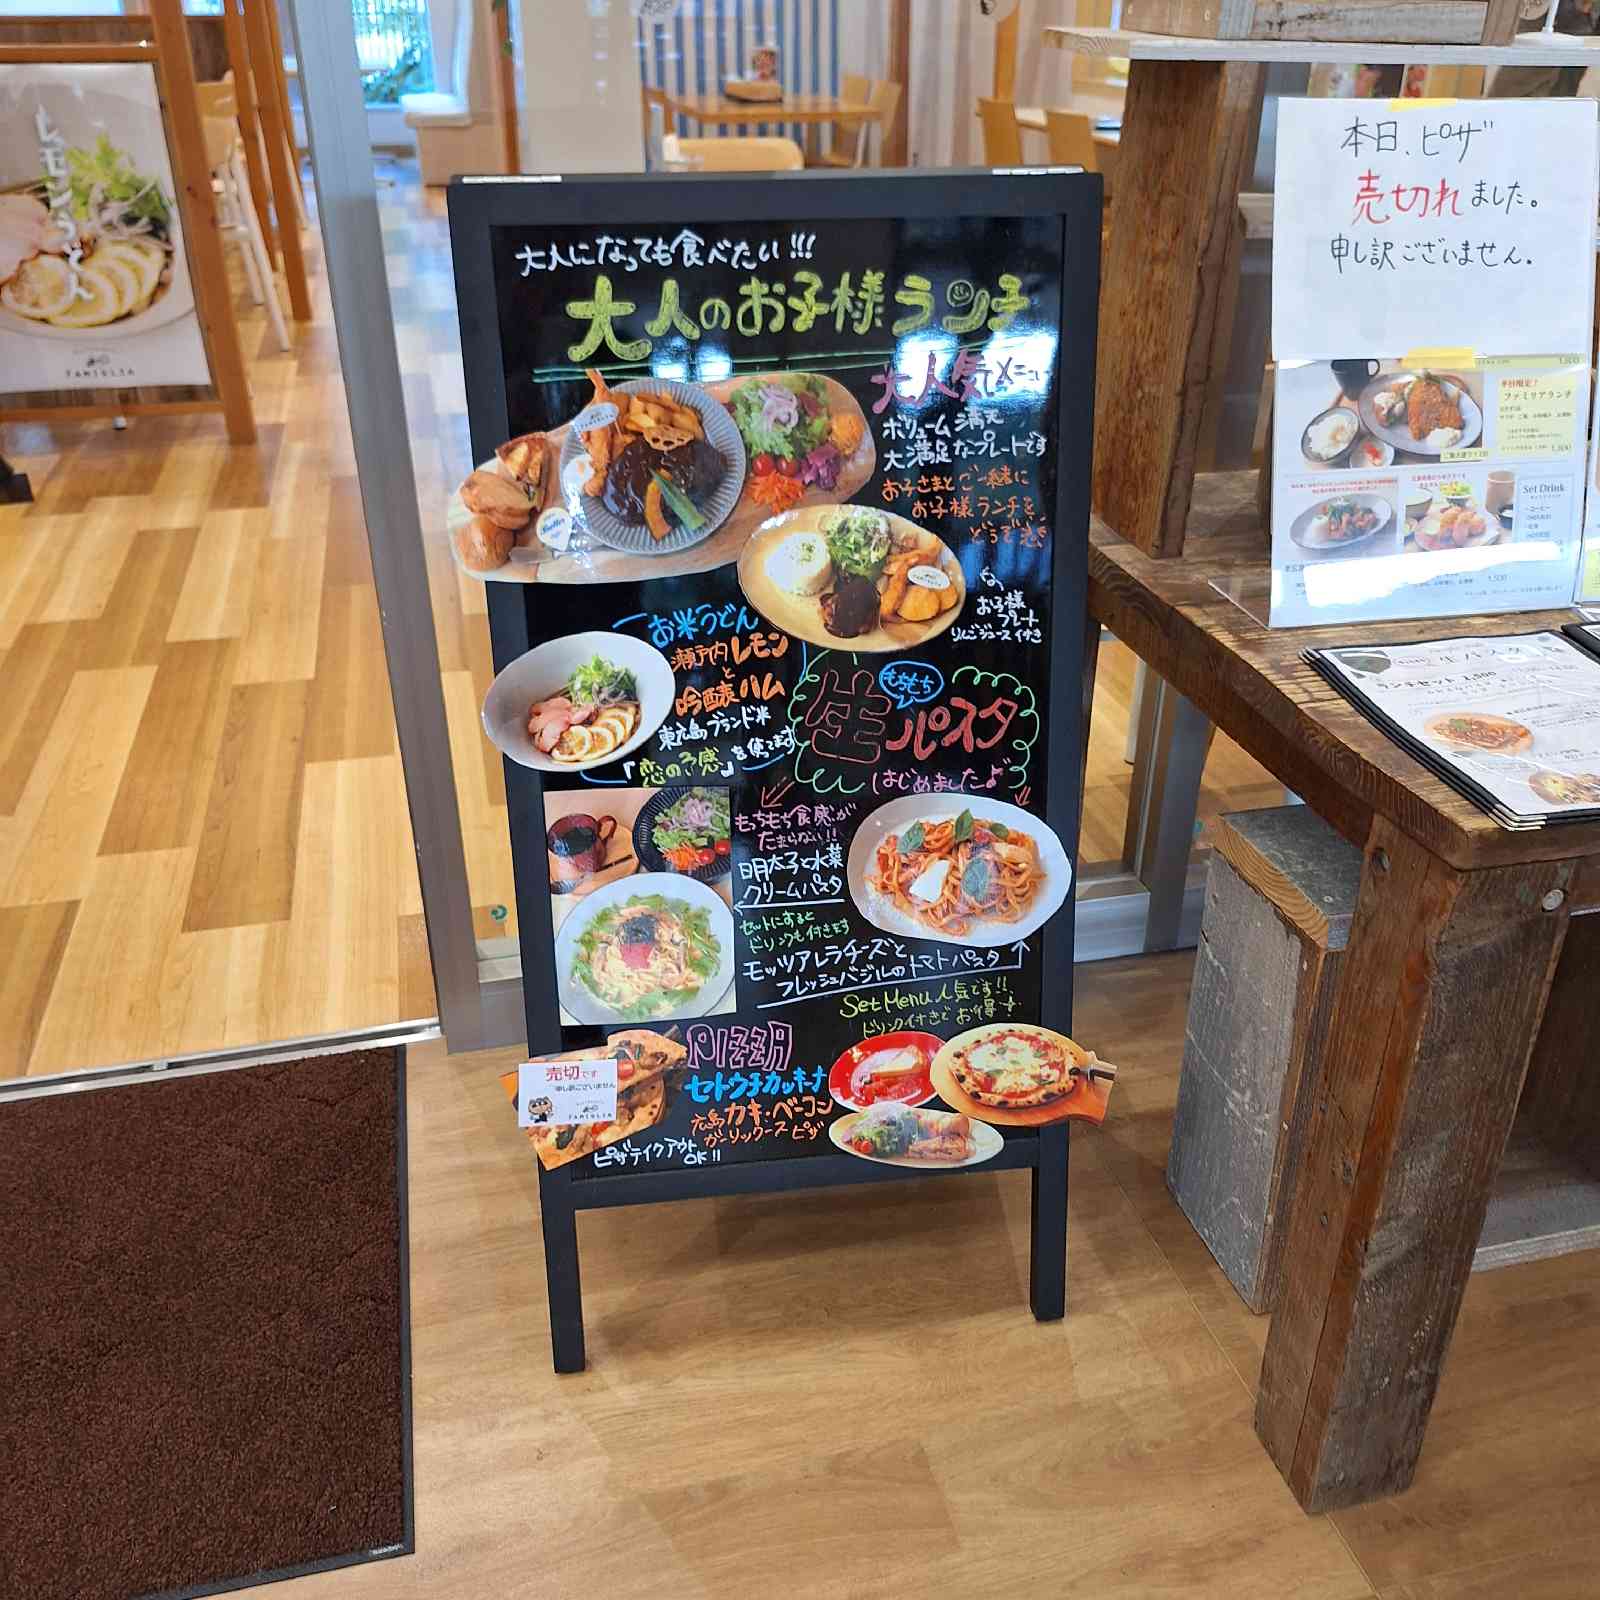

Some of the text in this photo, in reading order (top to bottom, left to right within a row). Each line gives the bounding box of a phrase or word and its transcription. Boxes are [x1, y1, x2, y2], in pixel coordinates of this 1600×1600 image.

[1340, 116, 1494, 163] 本日、ピザ
[1351, 168, 1539, 226] 売切れました。
[648, 603, 759, 648] お米うどん
[976, 590, 1026, 616] お子様
